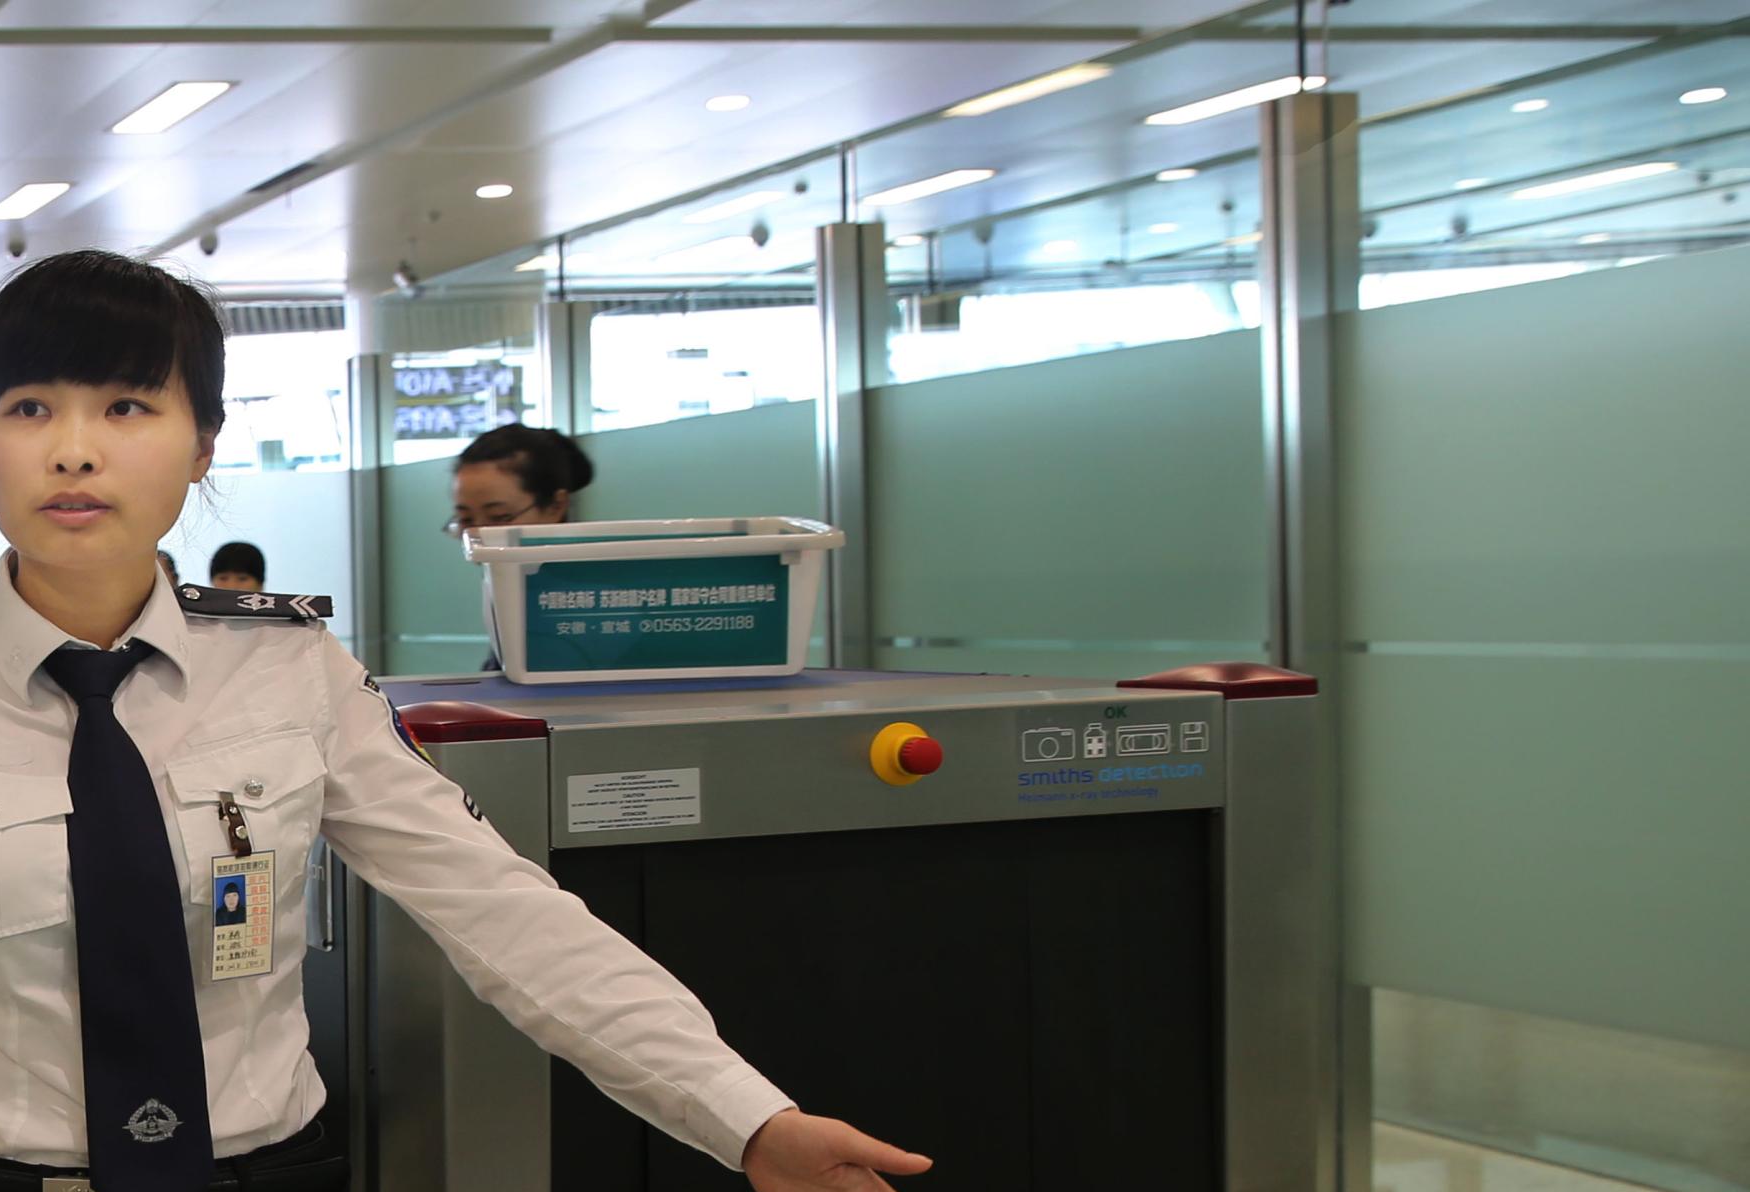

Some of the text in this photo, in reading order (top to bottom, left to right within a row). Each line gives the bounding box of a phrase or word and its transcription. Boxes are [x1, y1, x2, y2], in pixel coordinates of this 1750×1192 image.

[1104, 706, 1128, 719] OK
[1018, 762, 1205, 787] smiths detection
